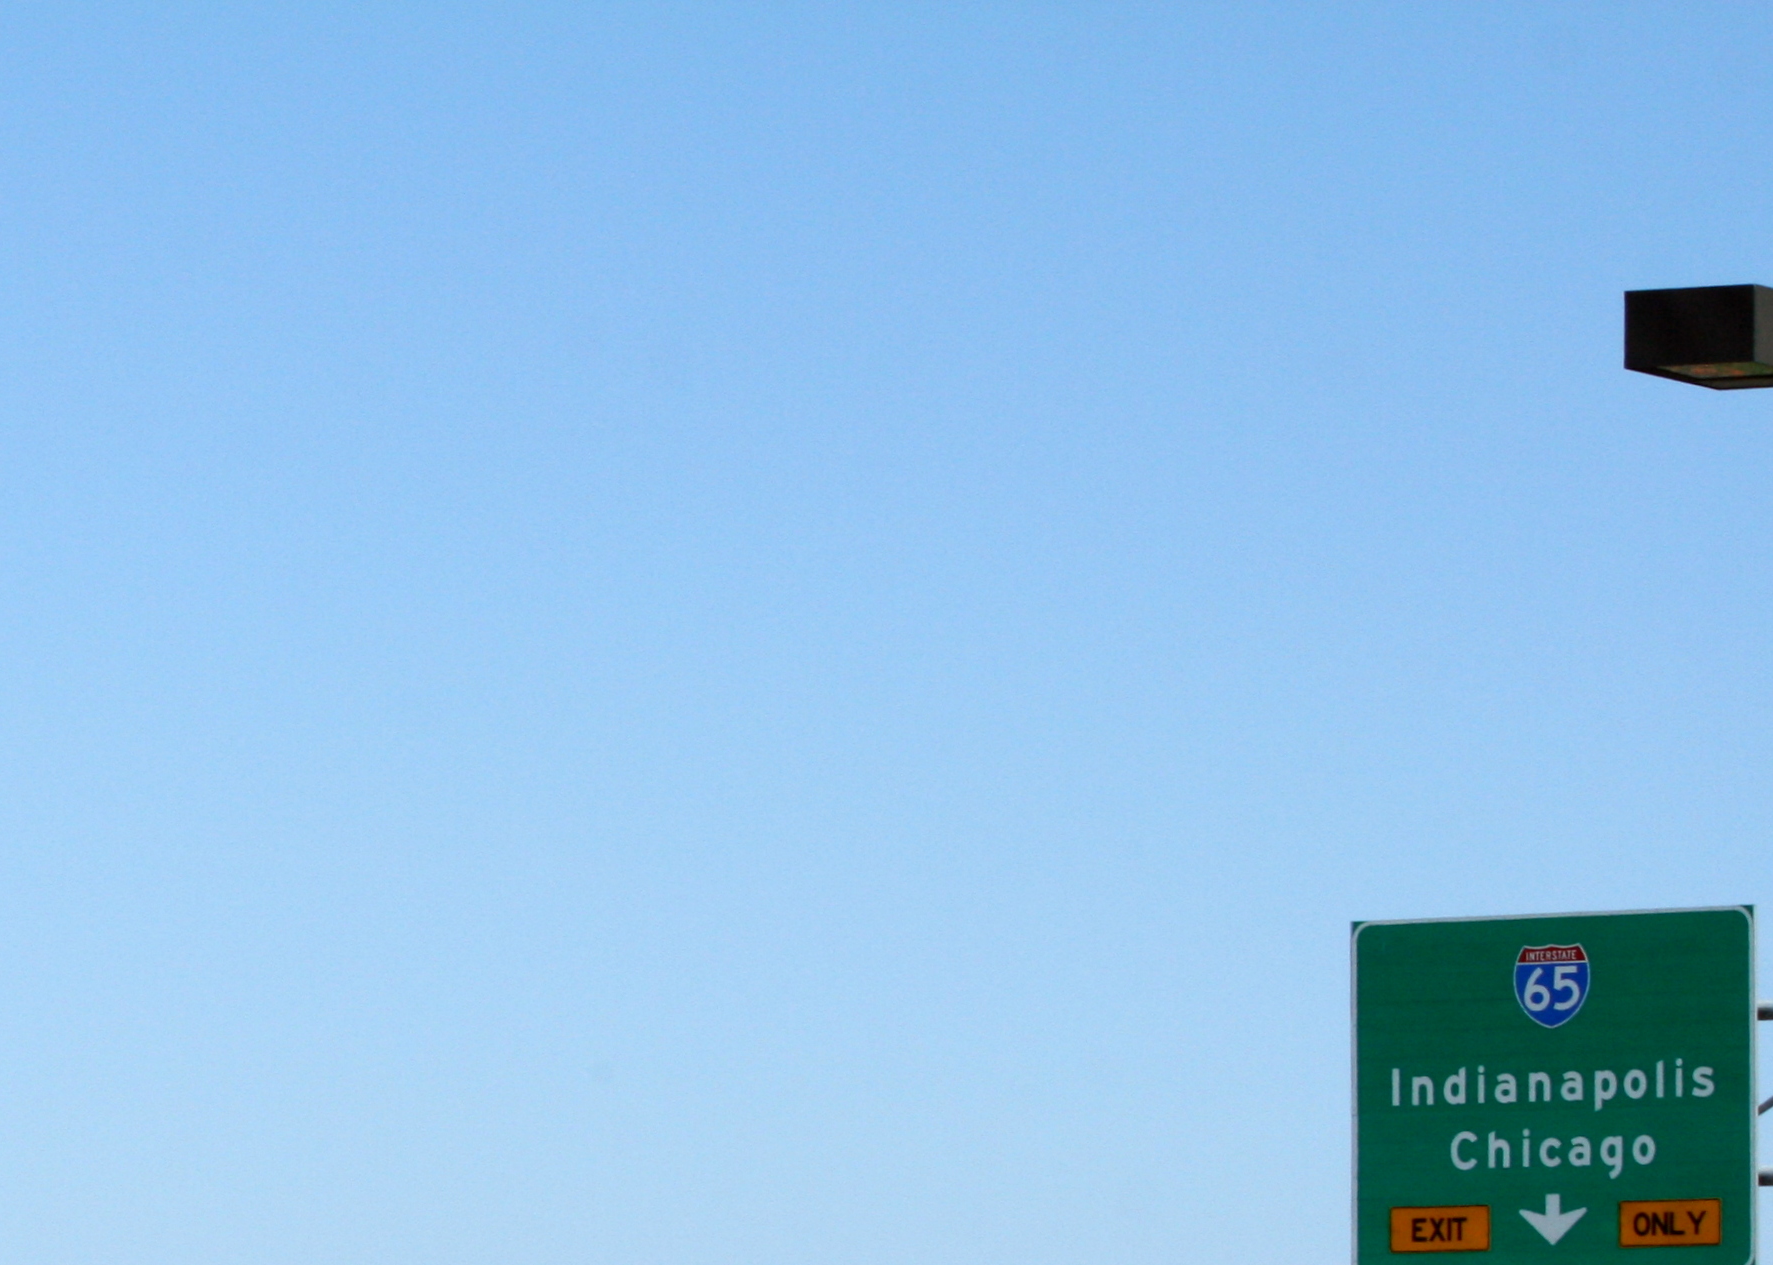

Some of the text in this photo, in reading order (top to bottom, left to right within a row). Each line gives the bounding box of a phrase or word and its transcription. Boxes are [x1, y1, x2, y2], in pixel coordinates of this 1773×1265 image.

[1526, 949, 1577, 961] INTERSTATE
[1524, 965, 1581, 1011] 65
[1391, 1058, 1715, 1111] Indianapolis
[1450, 1128, 1656, 1180] Chicago
[1411, 1210, 1707, 1243] EXIT ONLY
